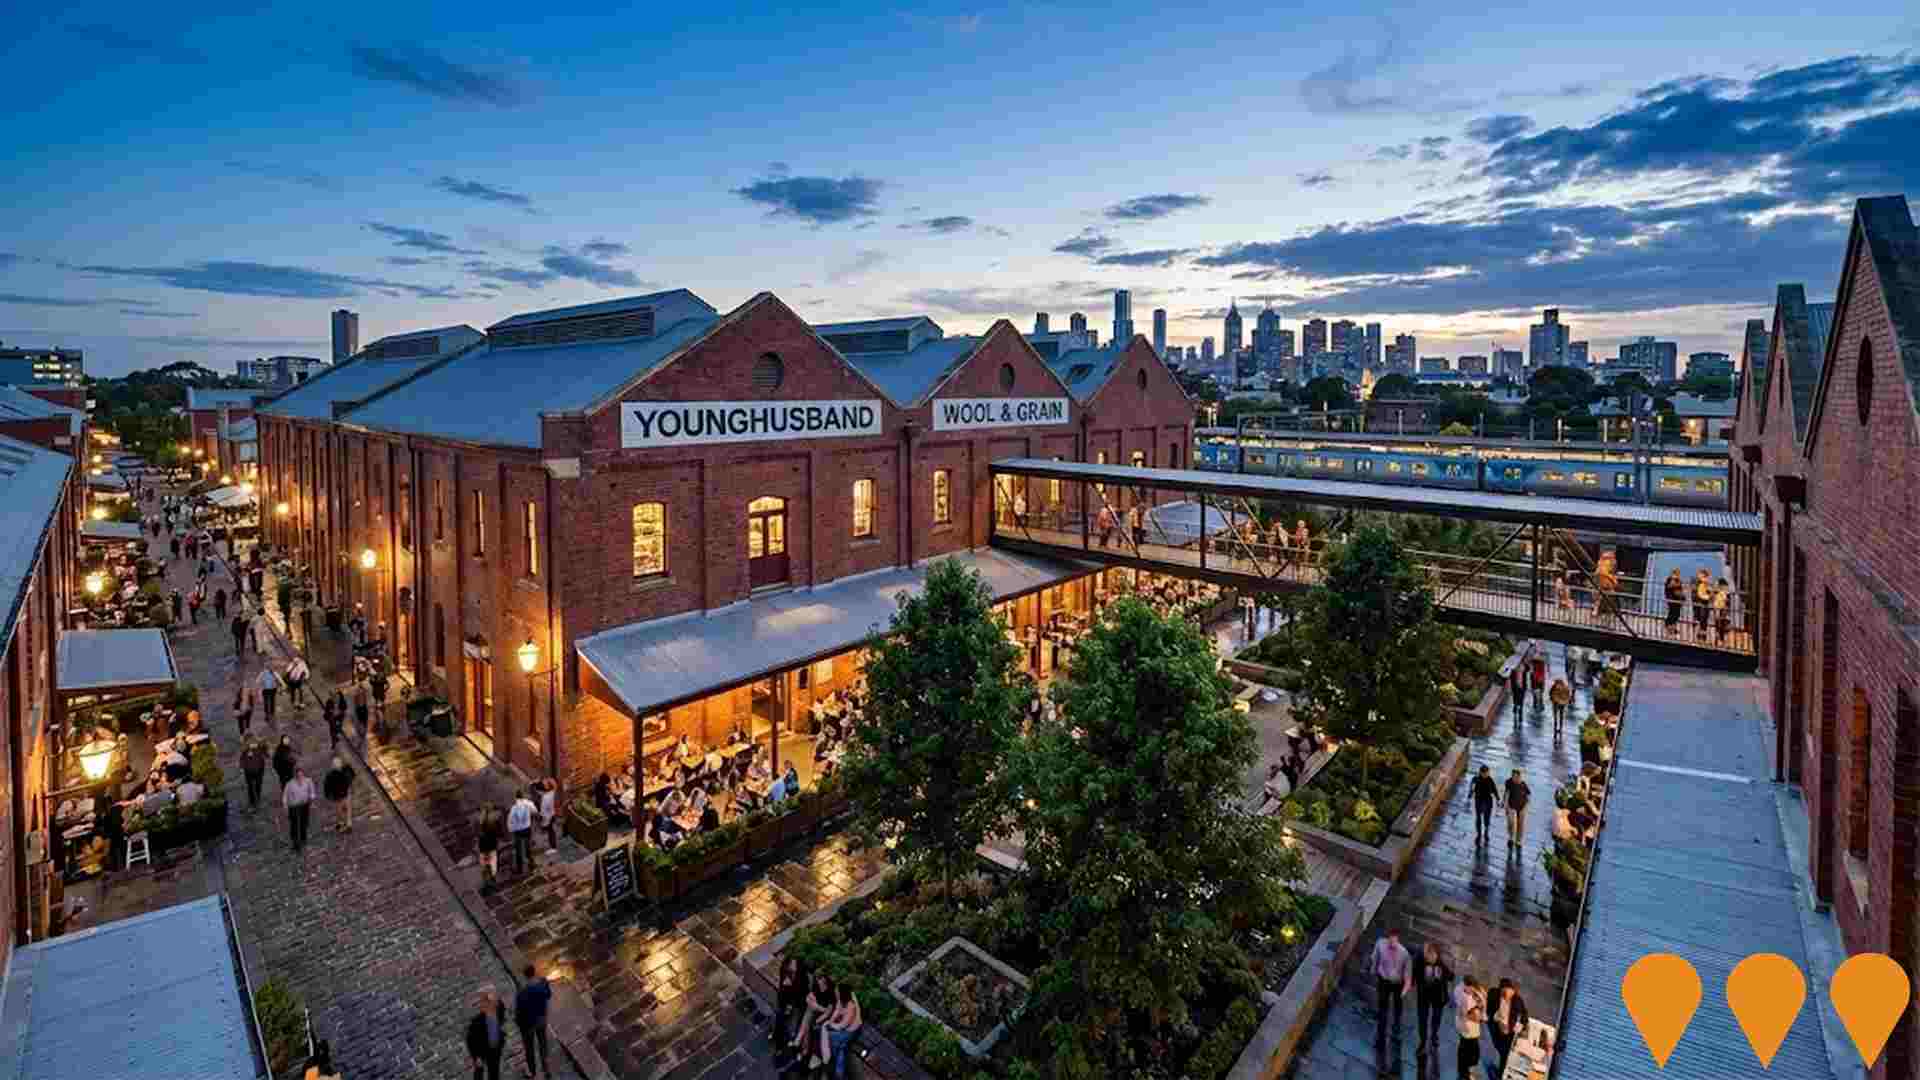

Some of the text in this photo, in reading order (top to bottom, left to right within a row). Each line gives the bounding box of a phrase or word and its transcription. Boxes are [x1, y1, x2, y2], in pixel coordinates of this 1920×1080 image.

[634, 405, 873, 438] YOUNGHUSBAND
[943, 401, 1063, 424] WOOL & GRAIN
